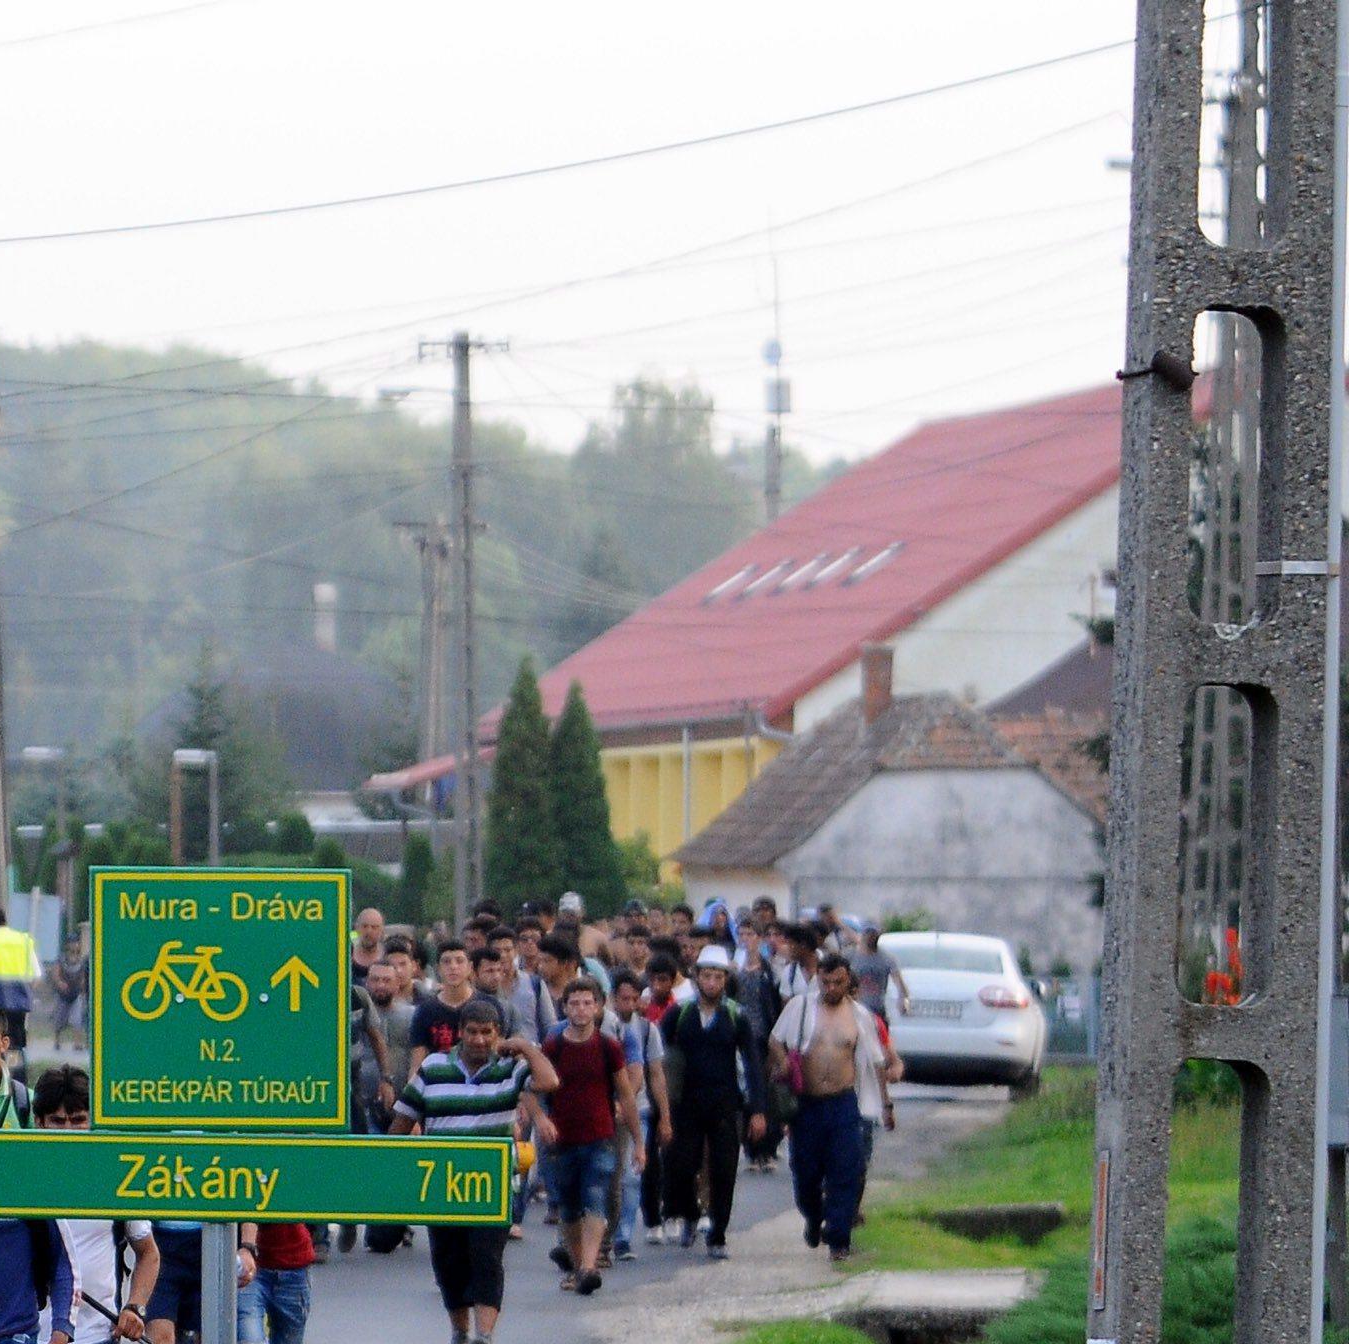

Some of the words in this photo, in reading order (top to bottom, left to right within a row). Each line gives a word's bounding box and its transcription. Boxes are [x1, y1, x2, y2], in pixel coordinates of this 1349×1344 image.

[119, 891, 197, 921] Mura
[231, 891, 324, 921] Dráva
[200, 1039, 242, 1063] N.2.
[111, 1076, 232, 1105] KERÉKPÁR
[239, 1076, 330, 1105] TÚRAÚT
[116, 1154, 280, 1210] Zákány
[417, 1160, 436, 1202] 7
[446, 1161, 492, 1203] km
